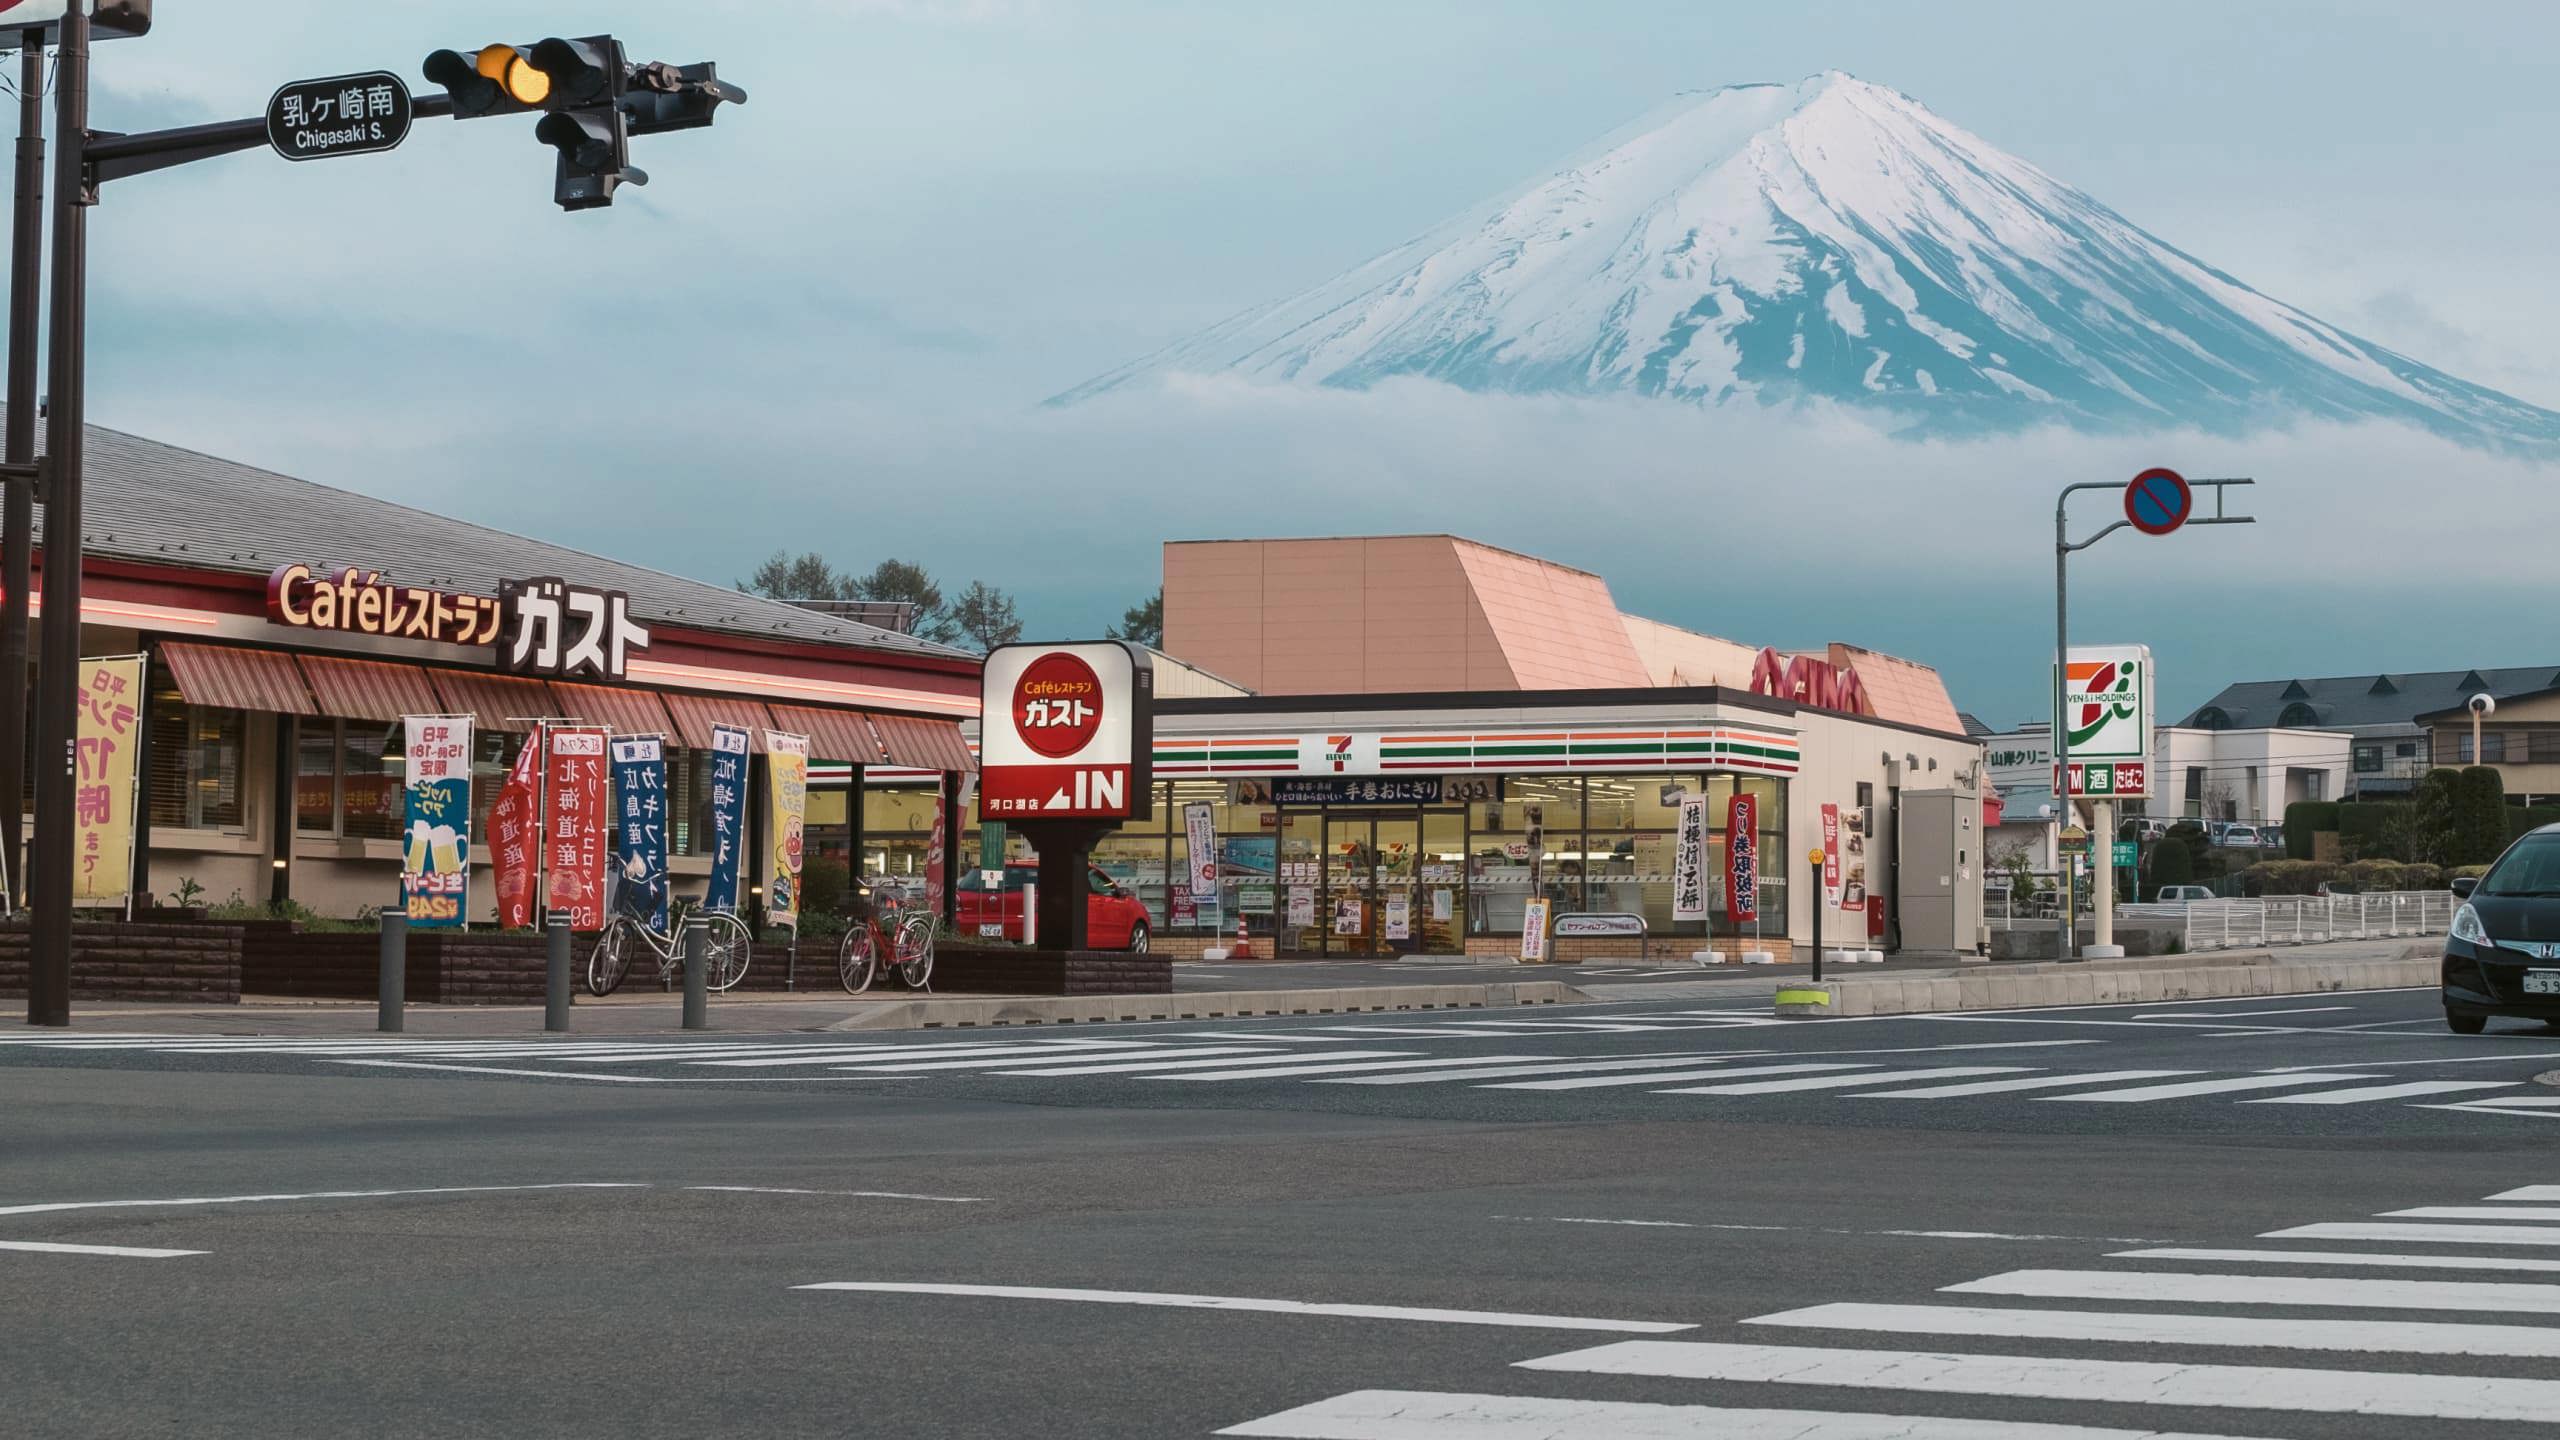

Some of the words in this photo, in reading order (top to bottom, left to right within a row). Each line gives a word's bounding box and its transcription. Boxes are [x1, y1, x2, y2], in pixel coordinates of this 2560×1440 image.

[296, 124, 365, 149] Chigasaki
[371, 122, 385, 140] S.
[280, 565, 501, 645] Caféレストラン
[513, 582, 649, 676] ガスト
[1024, 681, 1093, 695] Caféレストラン
[2096, 692, 2136, 702] HOLDINGS
[1024, 698, 1095, 728] ガスト
[2089, 769, 2109, 790] 酒
[2115, 768, 2145, 789] たばこ
[1074, 769, 1125, 811] IN
[1344, 781, 1438, 801] 手巻おにぎり
[989, 798, 1039, 811] 河口湖店
[1174, 887, 1190, 896] TAX
